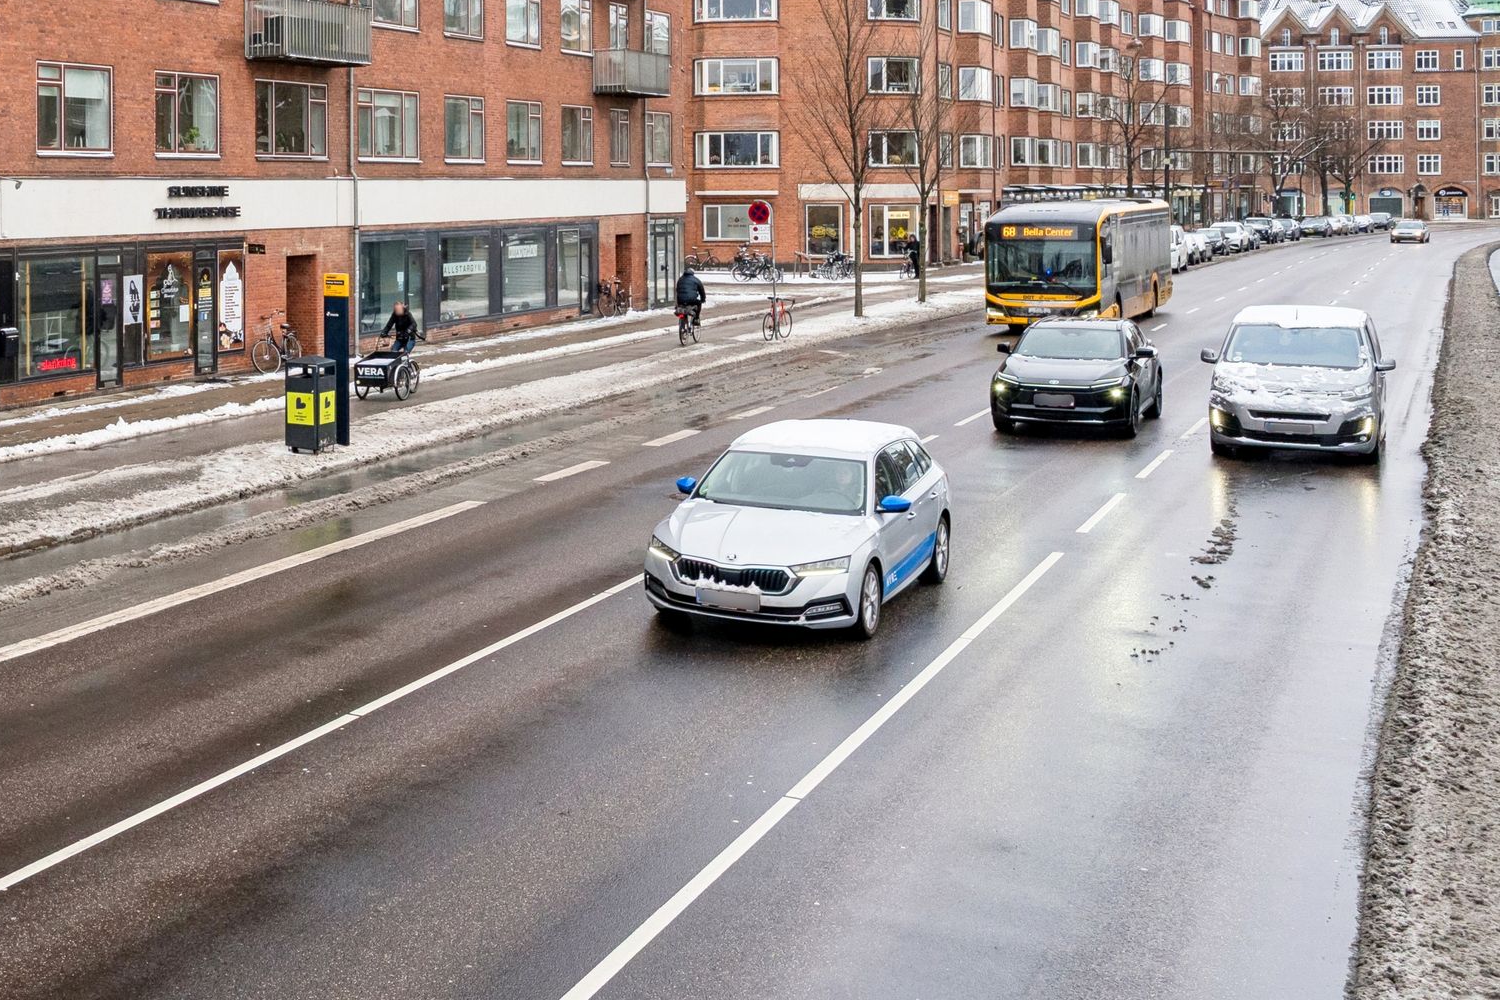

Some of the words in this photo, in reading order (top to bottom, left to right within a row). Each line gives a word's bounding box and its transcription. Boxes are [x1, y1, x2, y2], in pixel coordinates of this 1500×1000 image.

[167, 186, 230, 198] SUNSHINE
[1003, 226, 1016, 237] 68
[1023, 227, 1044, 236] Bella
[1045, 227, 1073, 237] Center
[357, 367, 385, 376] VERA
